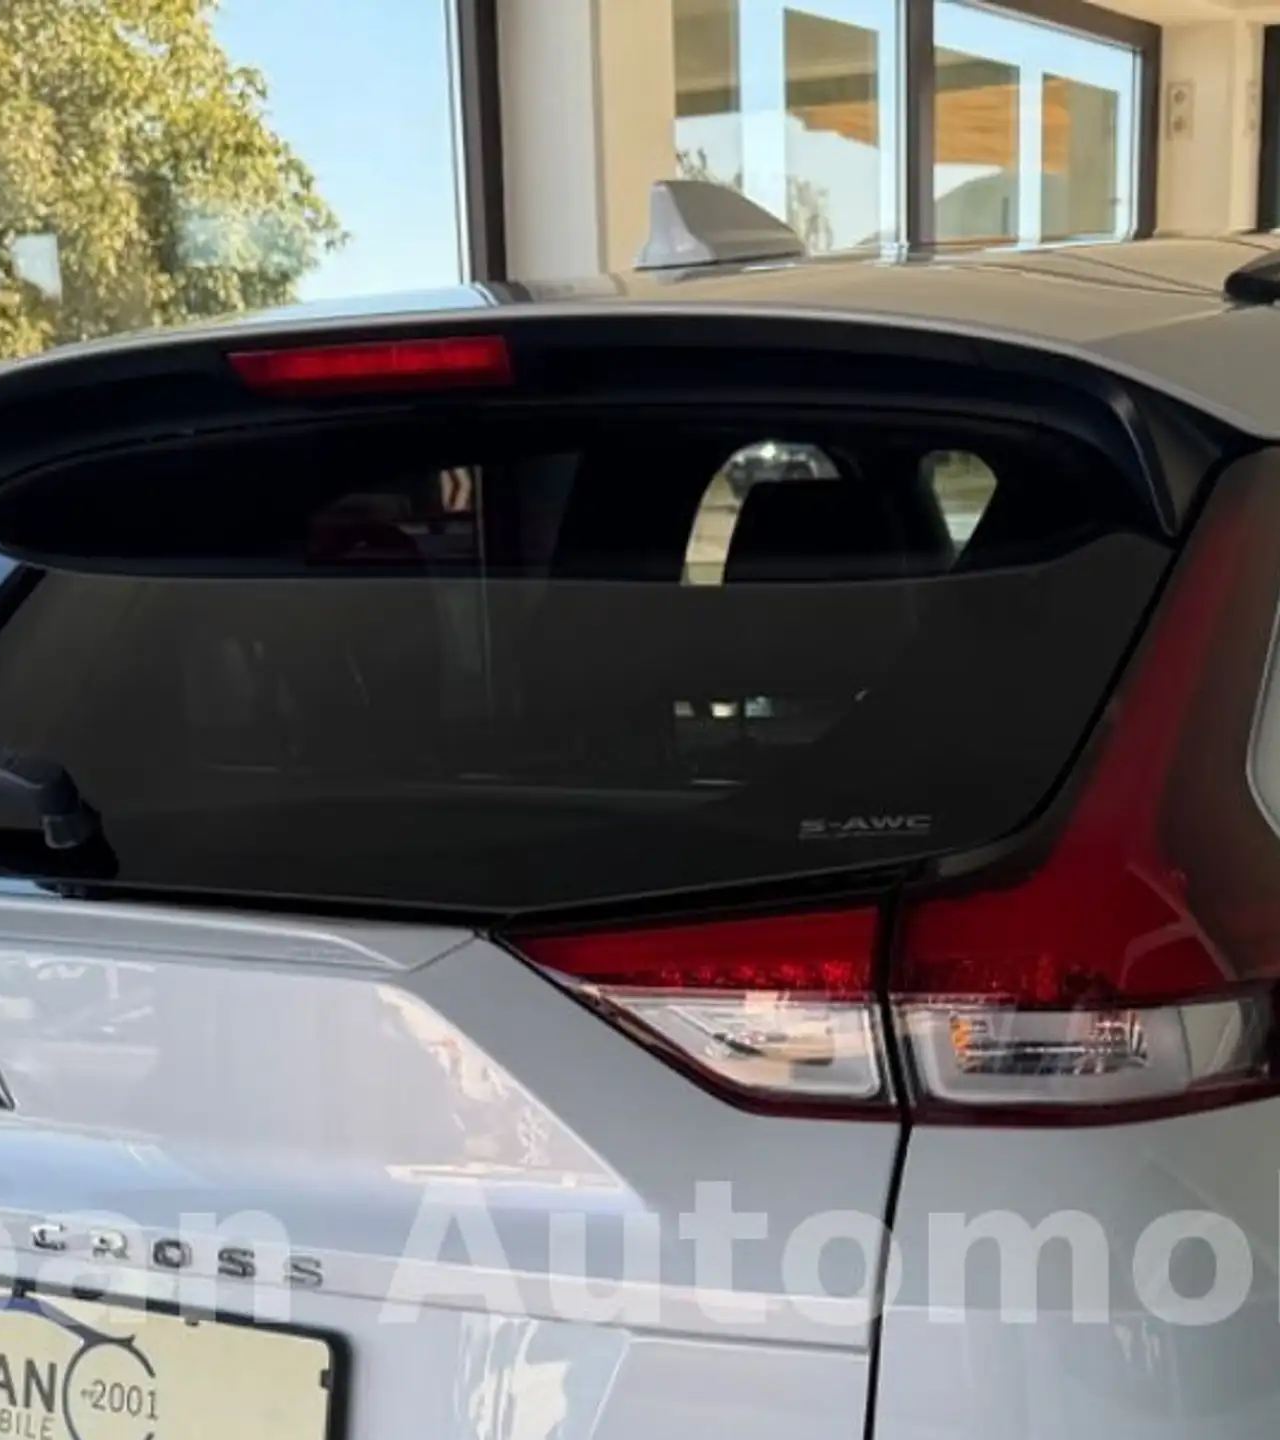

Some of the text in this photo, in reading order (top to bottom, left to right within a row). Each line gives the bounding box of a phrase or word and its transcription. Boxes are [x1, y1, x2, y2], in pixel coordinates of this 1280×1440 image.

[799, 814, 932, 833] S-AWC
[30, 1223, 324, 1287] CROSS
[91, 1379, 159, 1421] 2001
